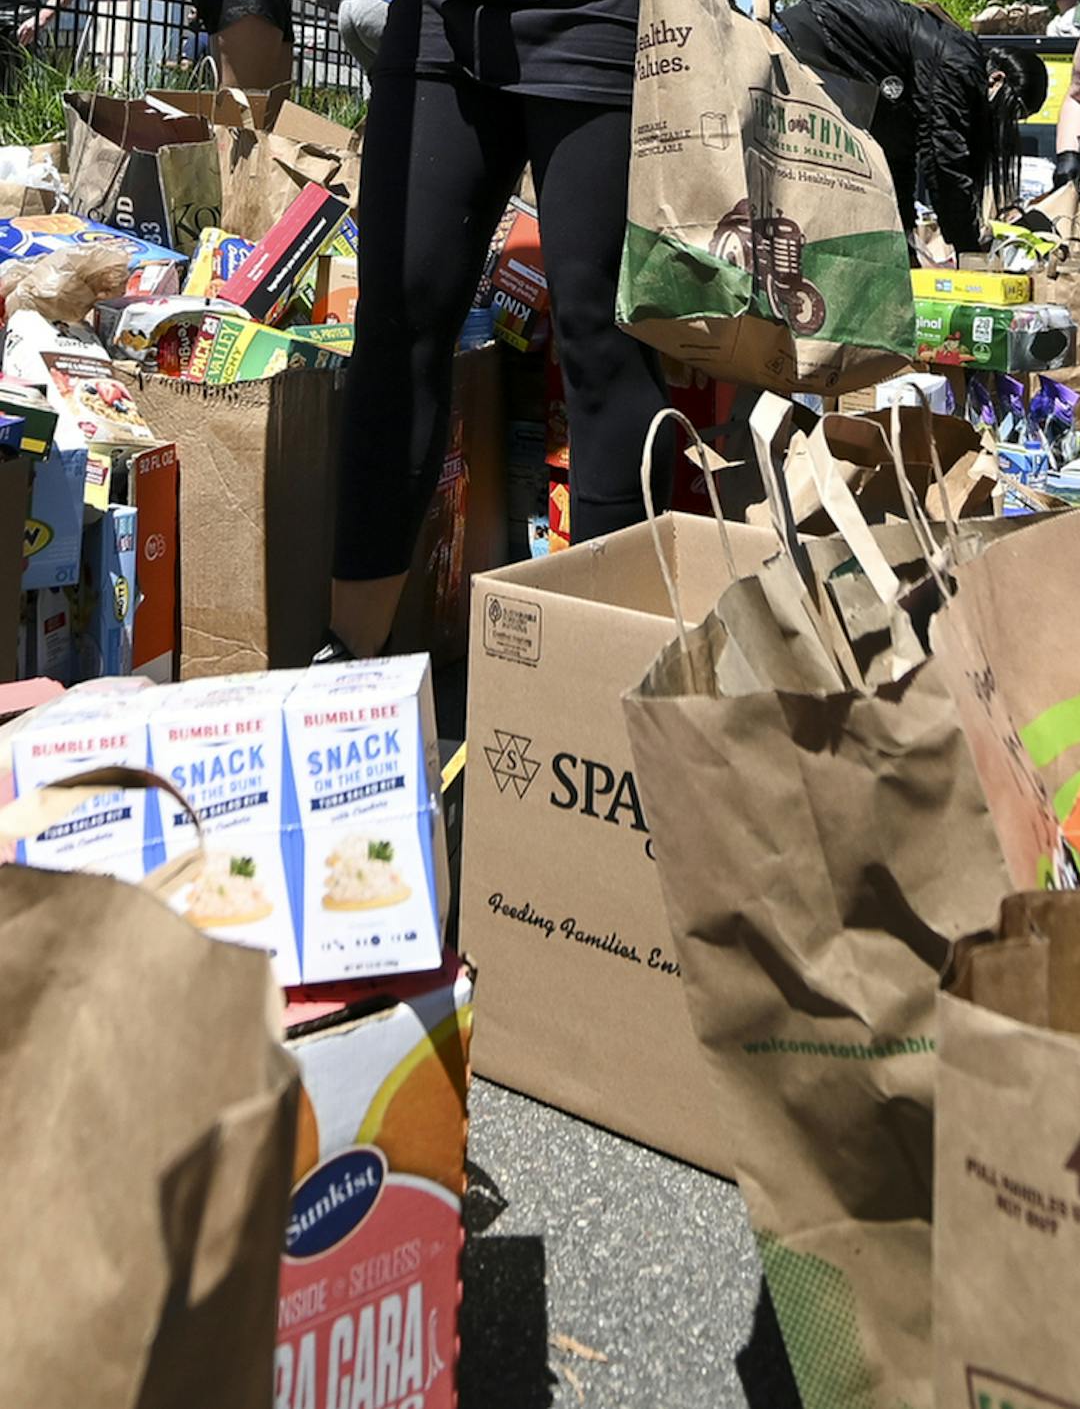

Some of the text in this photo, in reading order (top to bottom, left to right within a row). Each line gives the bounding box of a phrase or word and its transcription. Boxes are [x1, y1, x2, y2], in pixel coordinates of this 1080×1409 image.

[637, 54, 690, 80] alues.
[171, 202, 221, 246] KO
[493, 290, 532, 322] KIND
[190, 337, 213, 378] PACK
[208, 320, 239, 379] VALLEY
[169, 719, 264, 742] BUMBLE BEE
[304, 704, 399, 728] BUMBLE BEE
[32, 734, 129, 758] BUMBLE BEE
[171, 744, 266, 790] SNACK
[306, 728, 401, 776] SNACK
[507, 750, 517, 771] S
[201, 784, 224, 801] THE
[229, 775, 262, 794] RUN!
[314, 760, 399, 793] ON THE RUN!
[550, 752, 650, 834] SPA
[487, 892, 556, 939] Feeding
[285, 1165, 379, 1248] Sunkist
[1001, 1174, 1068, 1219] HANDLES
[349, 1238, 423, 1296] SEEDLESS
[325, 1281, 424, 1409] CARA
